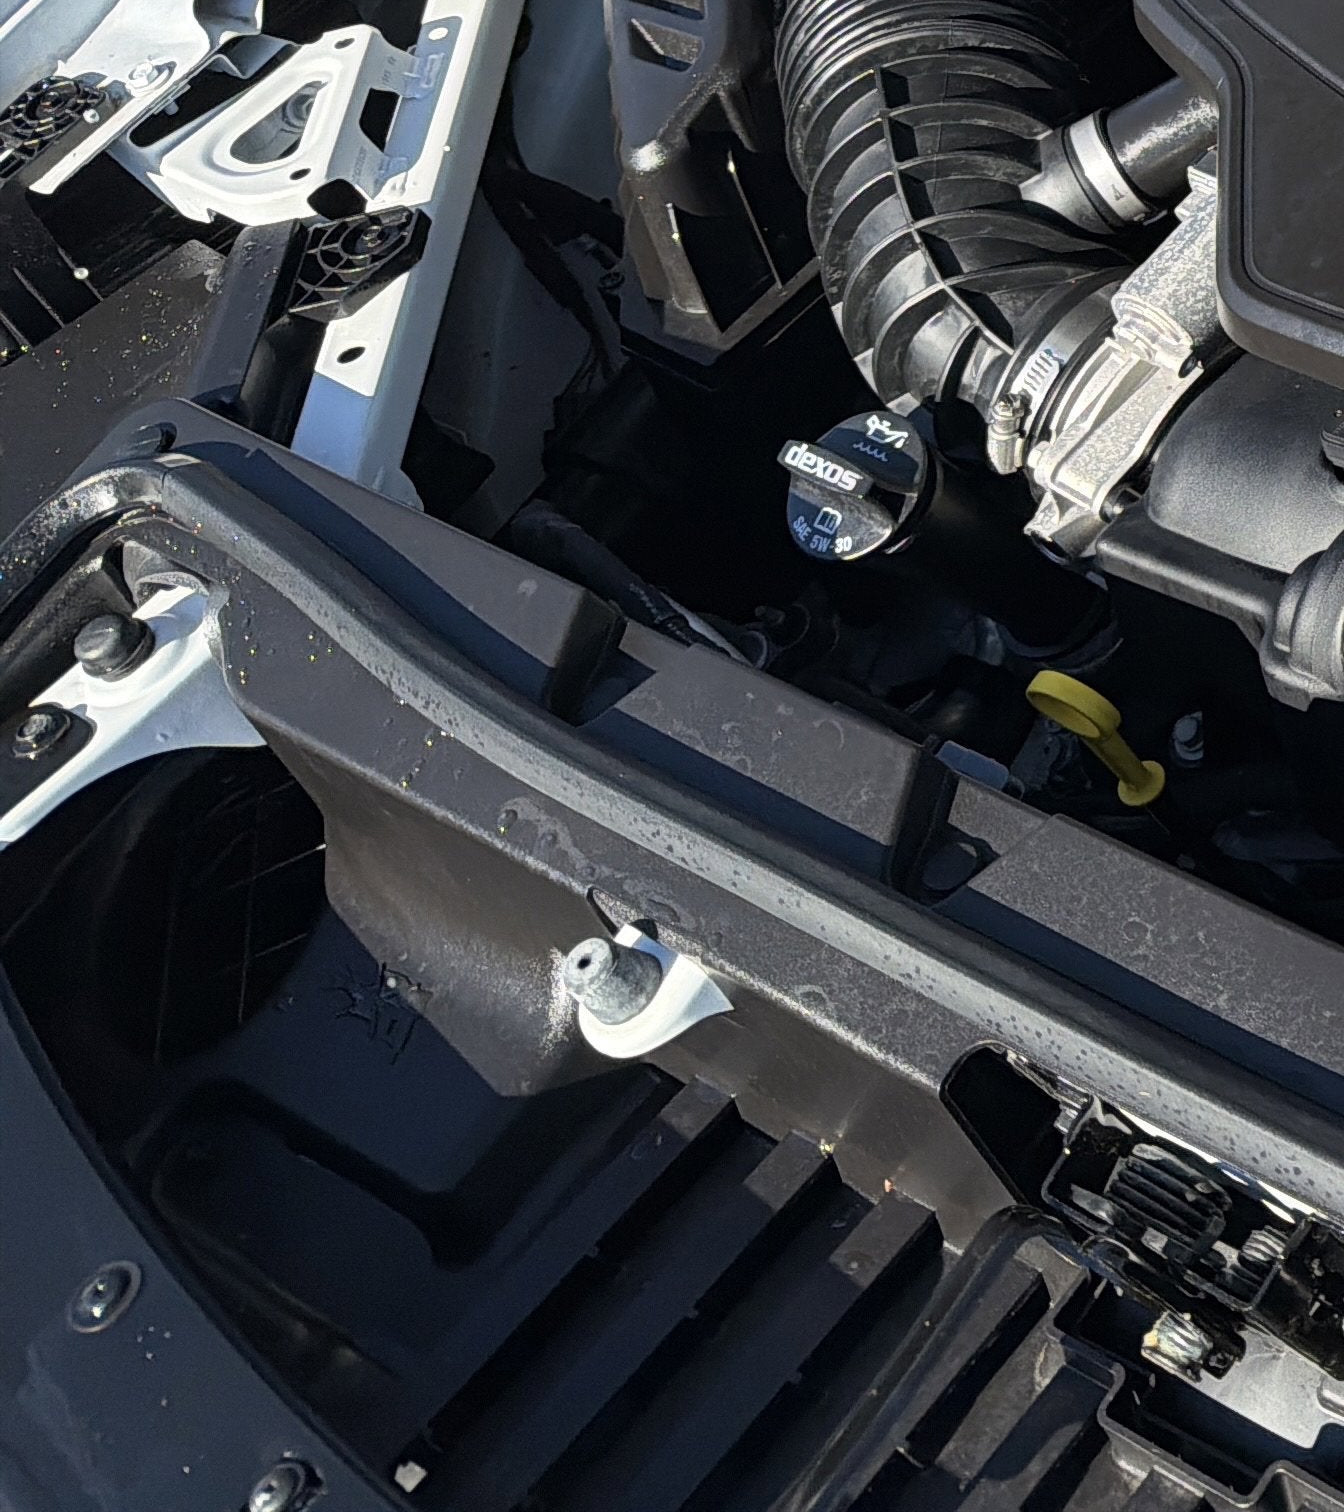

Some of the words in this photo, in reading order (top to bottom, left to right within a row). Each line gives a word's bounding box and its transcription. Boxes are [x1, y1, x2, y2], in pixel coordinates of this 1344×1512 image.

[784, 443, 864, 491] dexos
[793, 515, 812, 542] SAE
[810, 536, 853, 554] 5W-30
